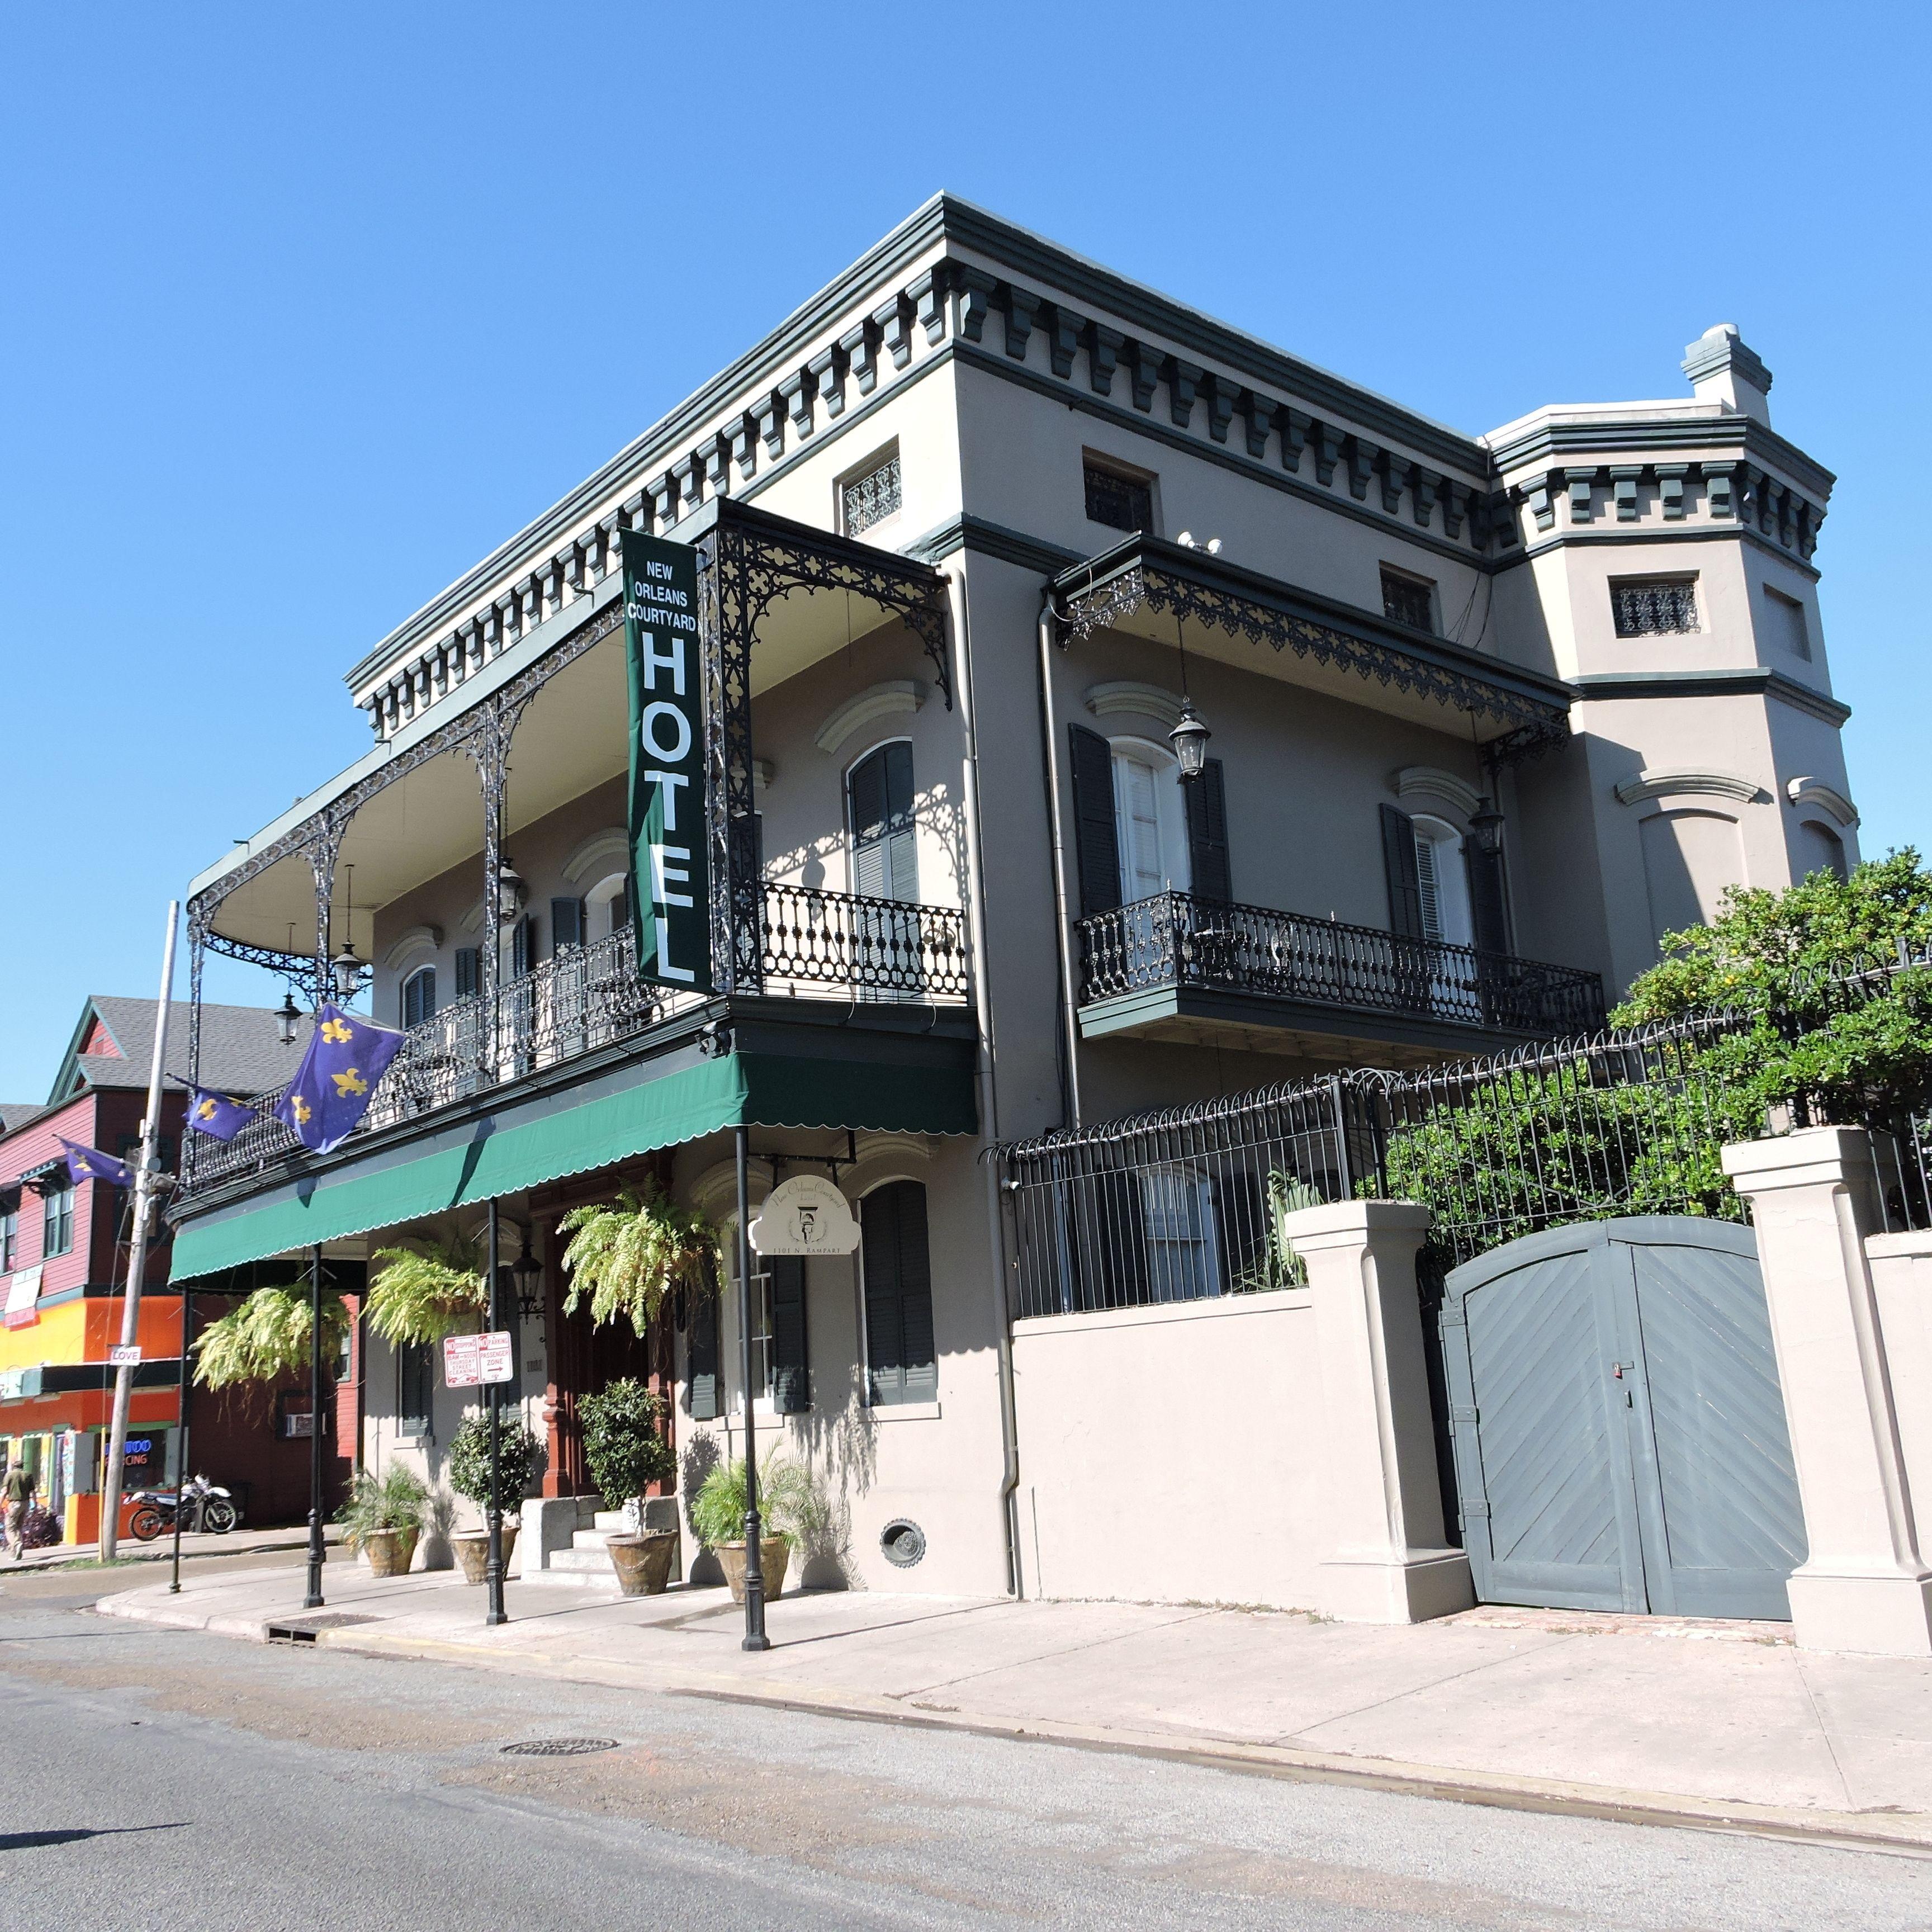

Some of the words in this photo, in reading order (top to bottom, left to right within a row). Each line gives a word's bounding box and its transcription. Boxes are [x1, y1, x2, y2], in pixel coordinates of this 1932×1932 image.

[647, 561, 673, 580] NEW
[635, 581, 687, 607] ORLEANS
[628, 602, 696, 632] COURTYARD
[642, 631, 694, 982] HOTEL
[446, 1342, 455, 1352] NO
[479, 1339, 488, 1348] NO
[113, 1351, 139, 1360] LOVE
[480, 1350, 509, 1358] PASSENGER
